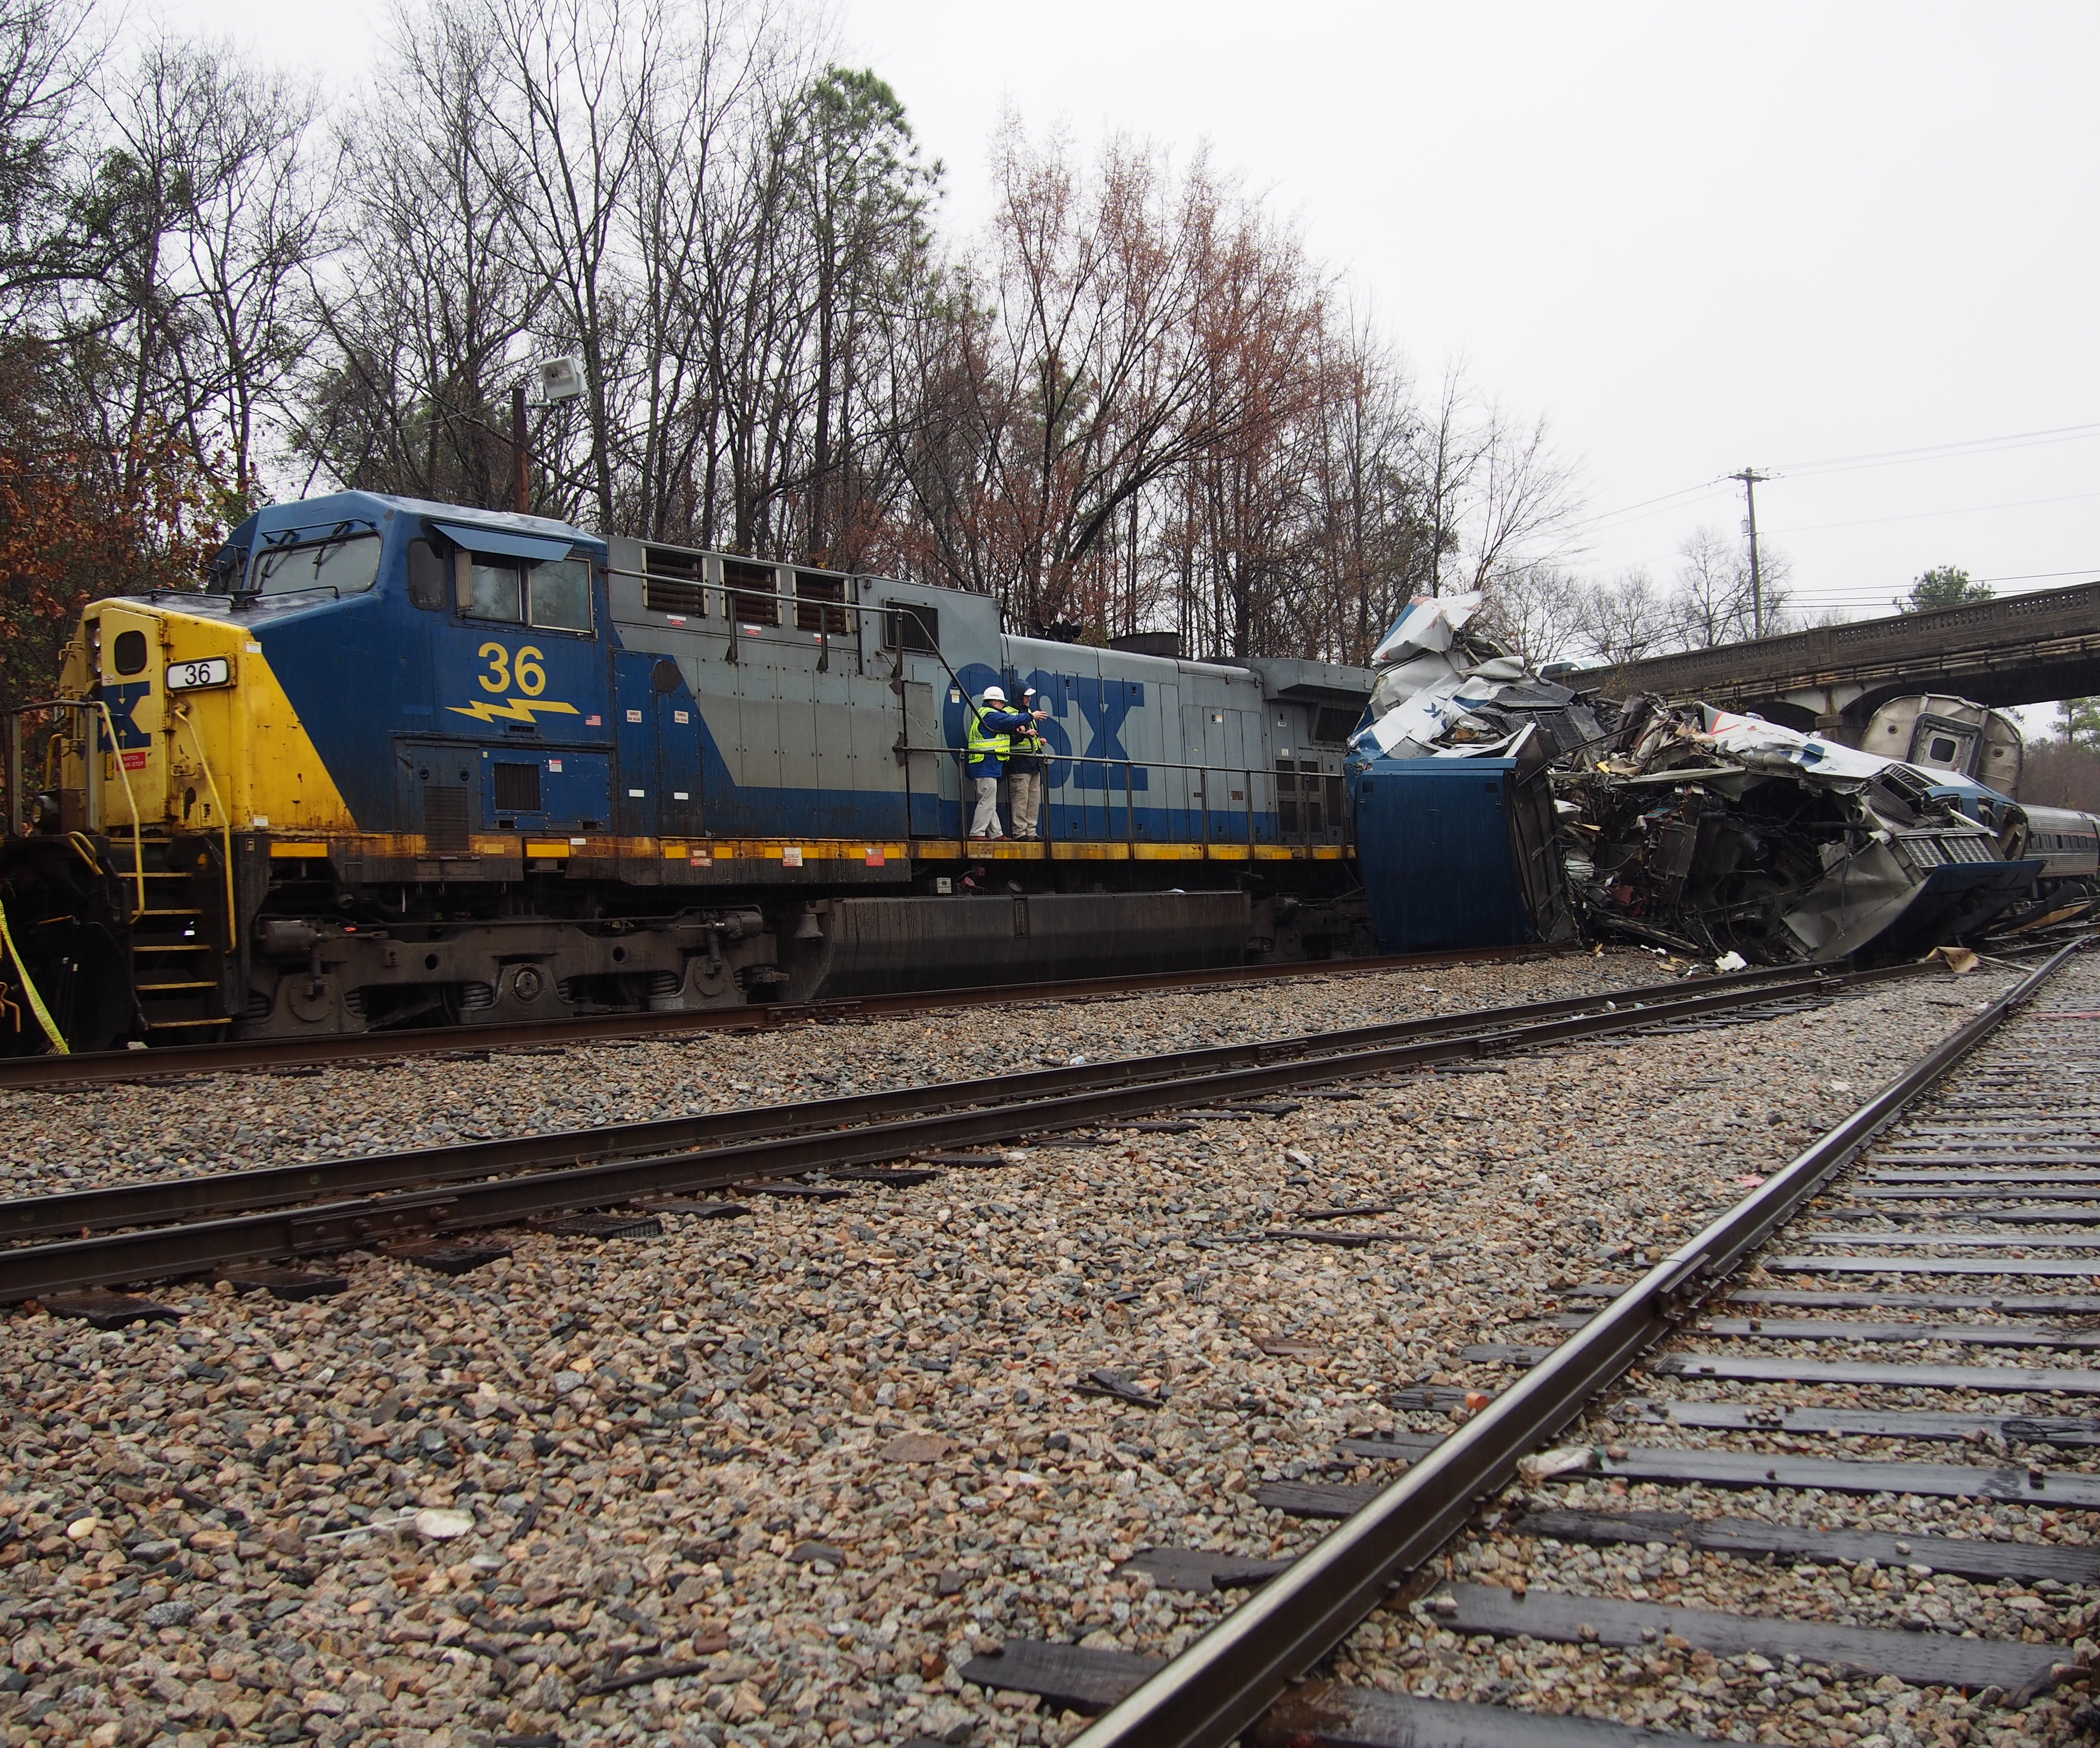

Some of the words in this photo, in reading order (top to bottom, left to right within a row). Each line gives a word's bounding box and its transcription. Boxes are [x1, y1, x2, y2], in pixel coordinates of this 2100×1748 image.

[185, 664, 210, 684] 36
[478, 642, 546, 696] 36
[943, 663, 1149, 791] CSX
[246, 839, 253, 850] F
